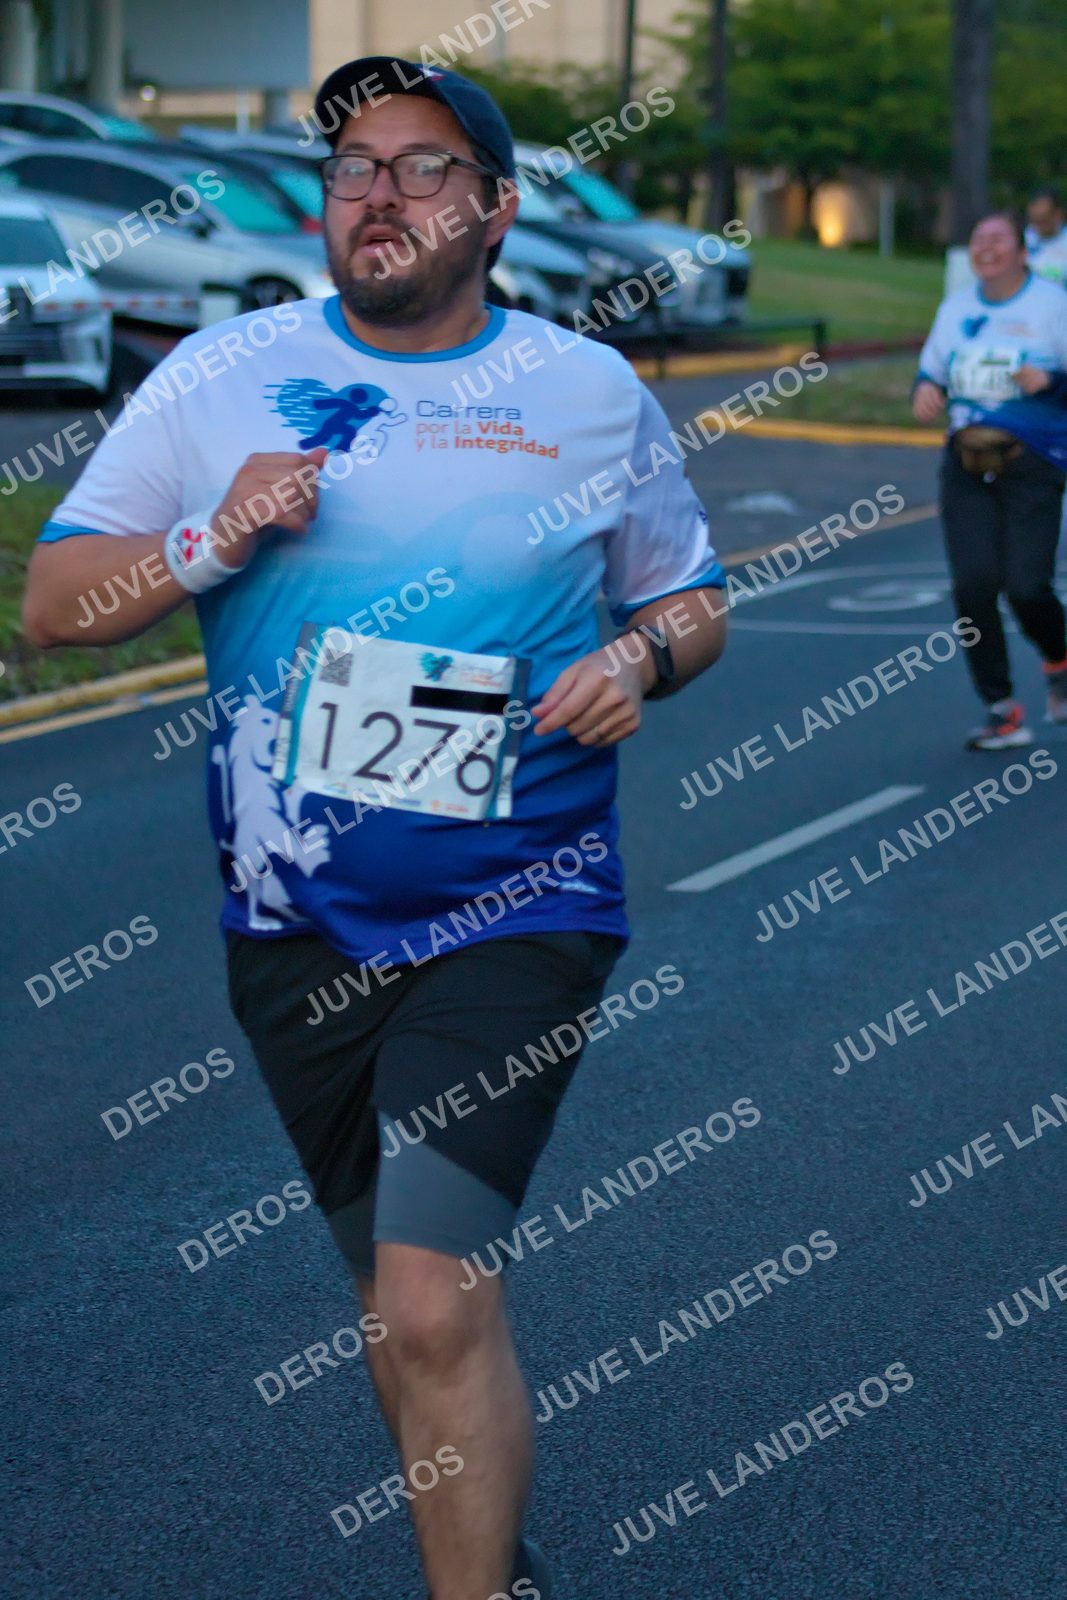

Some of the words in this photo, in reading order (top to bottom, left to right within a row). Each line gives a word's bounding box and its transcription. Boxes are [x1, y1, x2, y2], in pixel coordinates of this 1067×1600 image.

[416, 400, 522, 420] Carrera
[416, 422, 450, 436] por
[454, 420, 472, 435] la
[477, 421, 525, 436] Vida
[416, 437, 426, 452] y
[431, 435, 448, 449] la
[454, 436, 559, 459] Integridad
[319, 701, 496, 797] 1276
